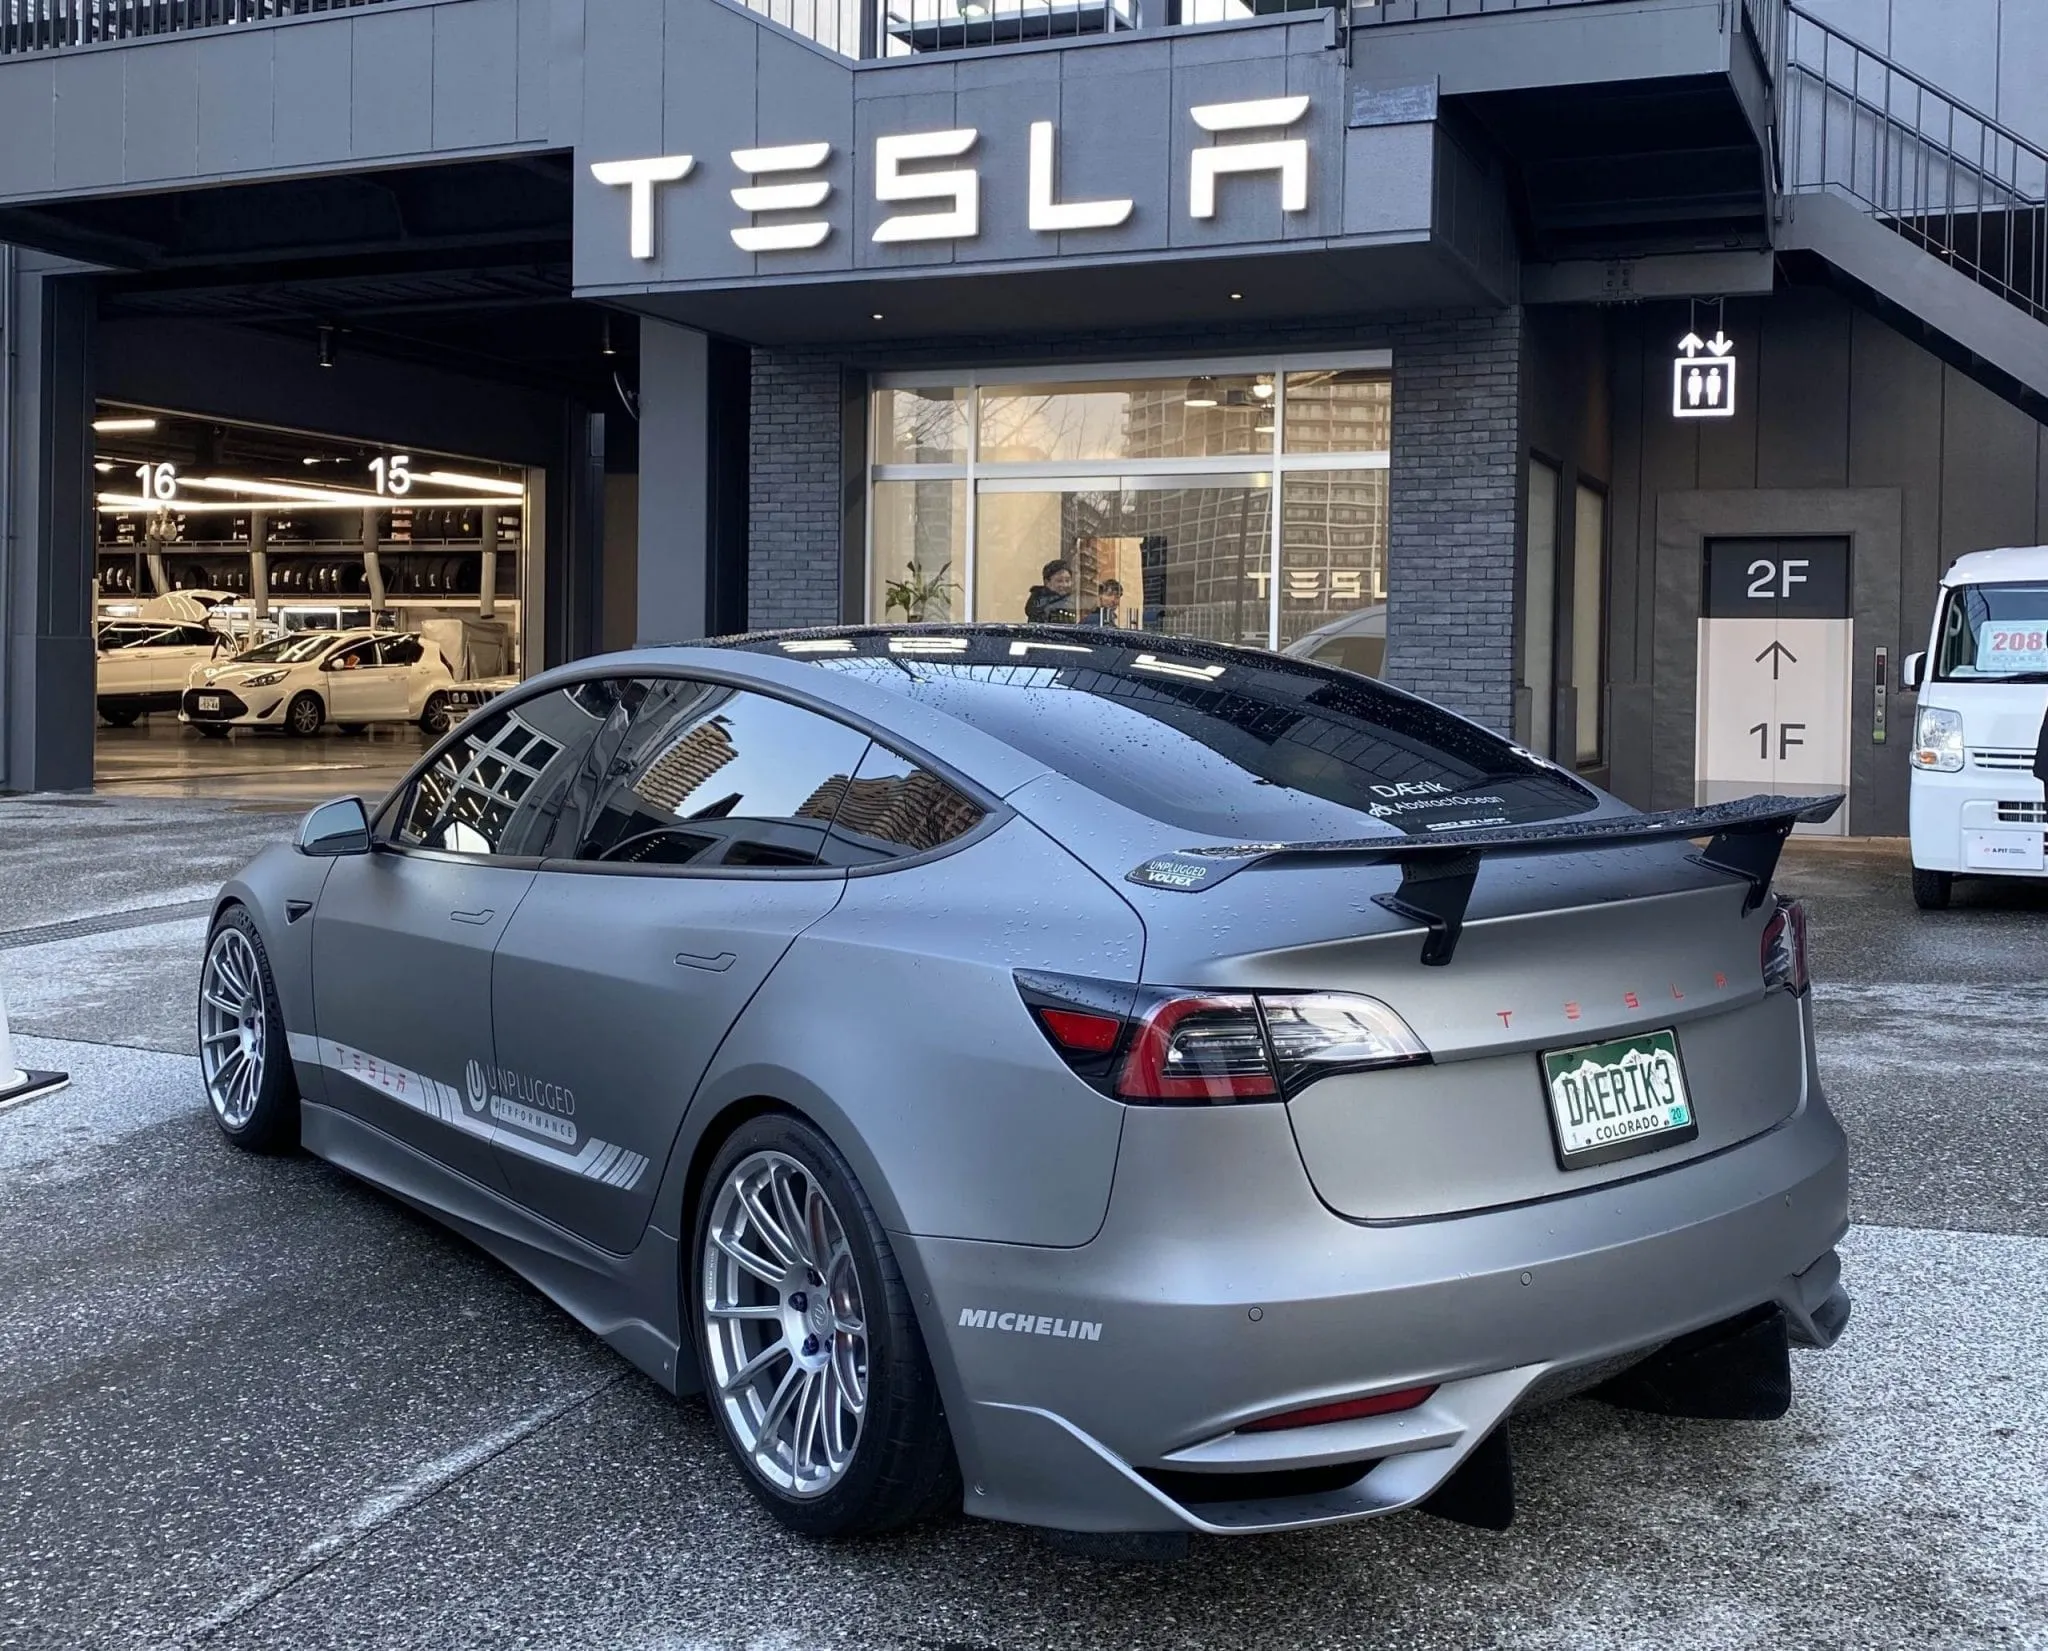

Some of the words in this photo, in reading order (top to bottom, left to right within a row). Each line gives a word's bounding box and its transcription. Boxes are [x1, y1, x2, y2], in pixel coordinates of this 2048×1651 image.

[591, 95, 1310, 259] TESLA
[135, 462, 176, 500] 16
[368, 455, 410, 495] 15
[1747, 559, 1809, 598] 2F
[1749, 723, 1806, 760] 1F
[1148, 872, 1195, 887] VOLTEX
[1150, 861, 1206, 877] UNPLUGGED
[1496, 972, 1729, 1029] TESLA
[336, 1047, 406, 1093] TESLA
[486, 1064, 575, 1116] UNPLUGGED
[1562, 1058, 1675, 1127] DAERIK3
[494, 1101, 573, 1138] PERFORMANCE
[1596, 1114, 1660, 1141] COLORADO
[1671, 1107, 1683, 1120] 20
[958, 1308, 1103, 1341] MICHELIN
